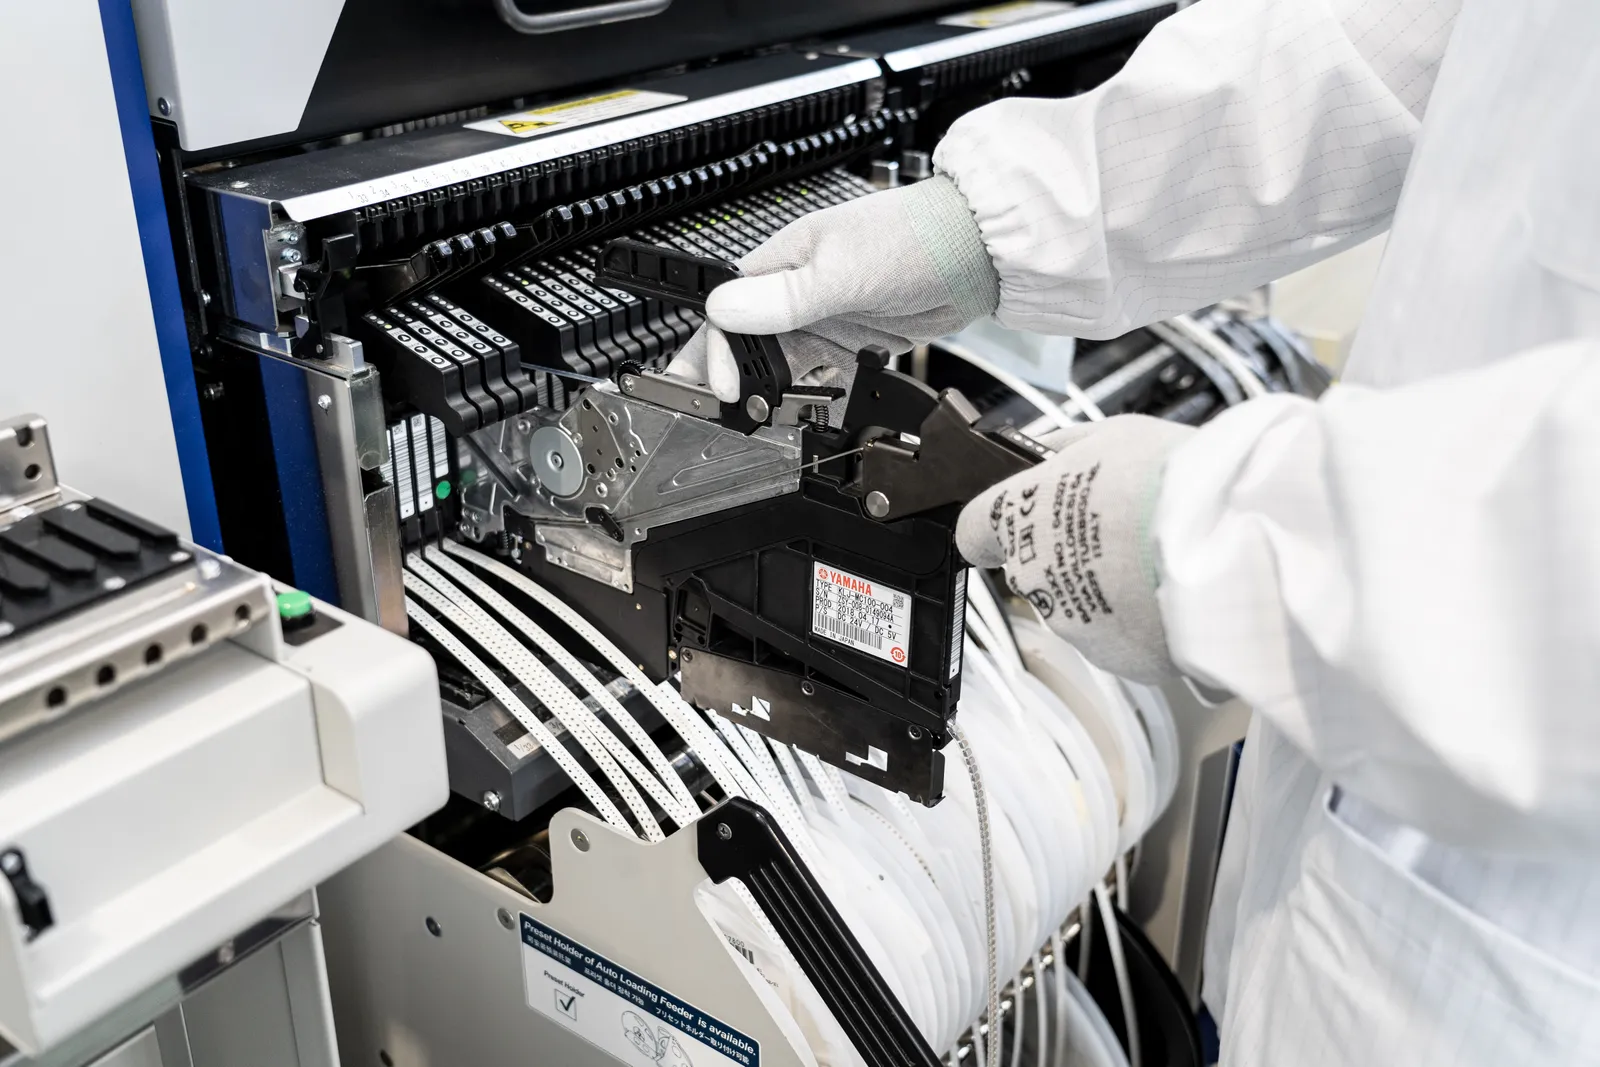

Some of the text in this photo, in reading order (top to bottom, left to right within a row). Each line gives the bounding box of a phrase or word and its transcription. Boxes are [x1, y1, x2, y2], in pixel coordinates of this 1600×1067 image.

[1007, 515, 1015, 558] SIZE
[1090, 512, 1102, 558] ITALY
[816, 579, 832, 592] TYPE
[816, 588, 828, 598] S/N
[830, 571, 872, 596] YAMAHA
[1060, 571, 1091, 624] BATCH
[814, 626, 827, 636] MADE
[839, 634, 854, 646] JAPAN
[816, 604, 828, 614] P/S
[838, 612, 846, 621] DC
[850, 617, 862, 627] 24V
[875, 626, 883, 635] DC
[888, 630, 897, 640] 5V
[524, 921, 756, 1056] Preset Holder of Auto Loading Feeder is available.
[544, 970, 585, 998] Preset Holder
